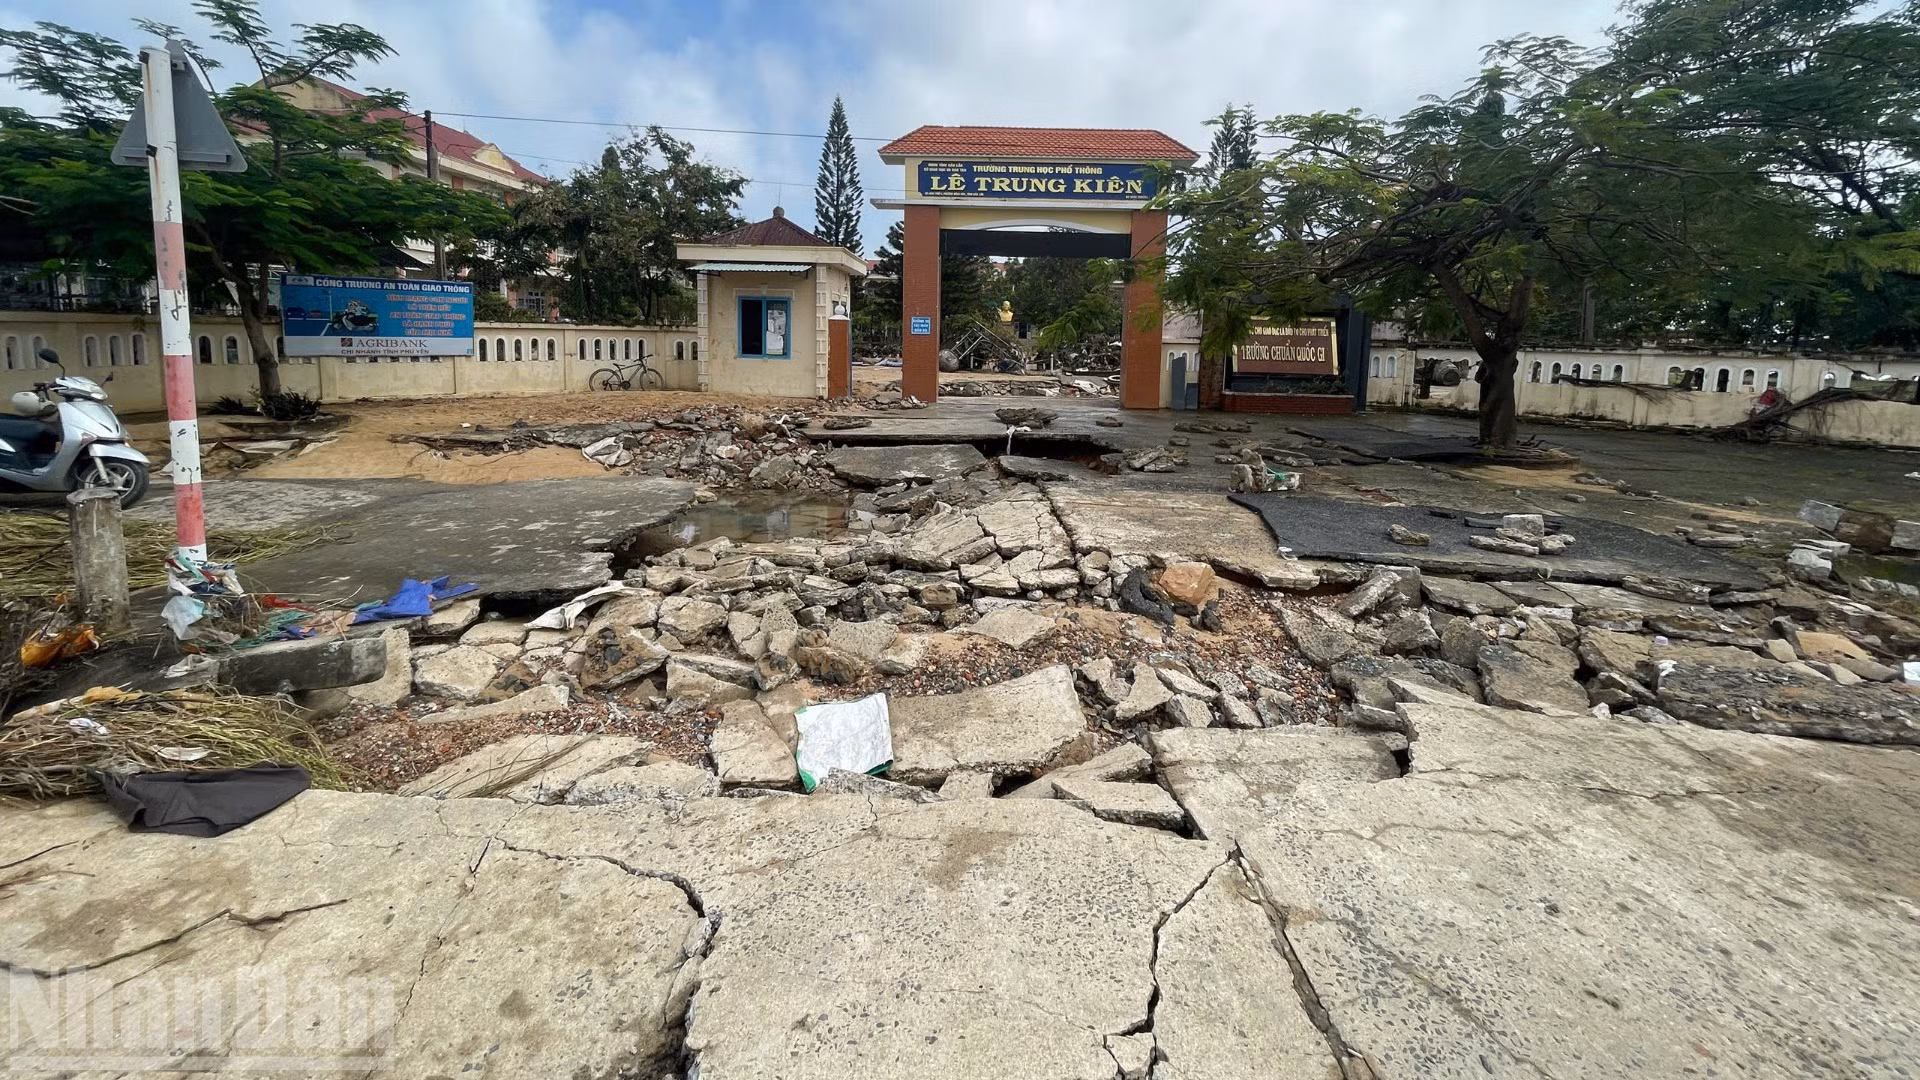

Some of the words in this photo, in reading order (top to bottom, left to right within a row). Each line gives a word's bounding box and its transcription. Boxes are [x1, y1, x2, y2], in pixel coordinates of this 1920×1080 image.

[972, 164, 1006, 173] TRƯỜNG
[1036, 166, 1054, 174] HỌC
[1074, 166, 1103, 174] THÔNG
[930, 173, 966, 191] LÊ
[973, 177, 1067, 193] TRUNG
[1072, 176, 1143, 194] KIÊN
[421, 284, 441, 292] GIAO
[443, 285, 470, 293] THÔNG
[356, 339, 428, 348] AGRIBANK
[1271, 340, 1295, 360] CHUẨN
[1296, 341, 1316, 361] QUỐC
